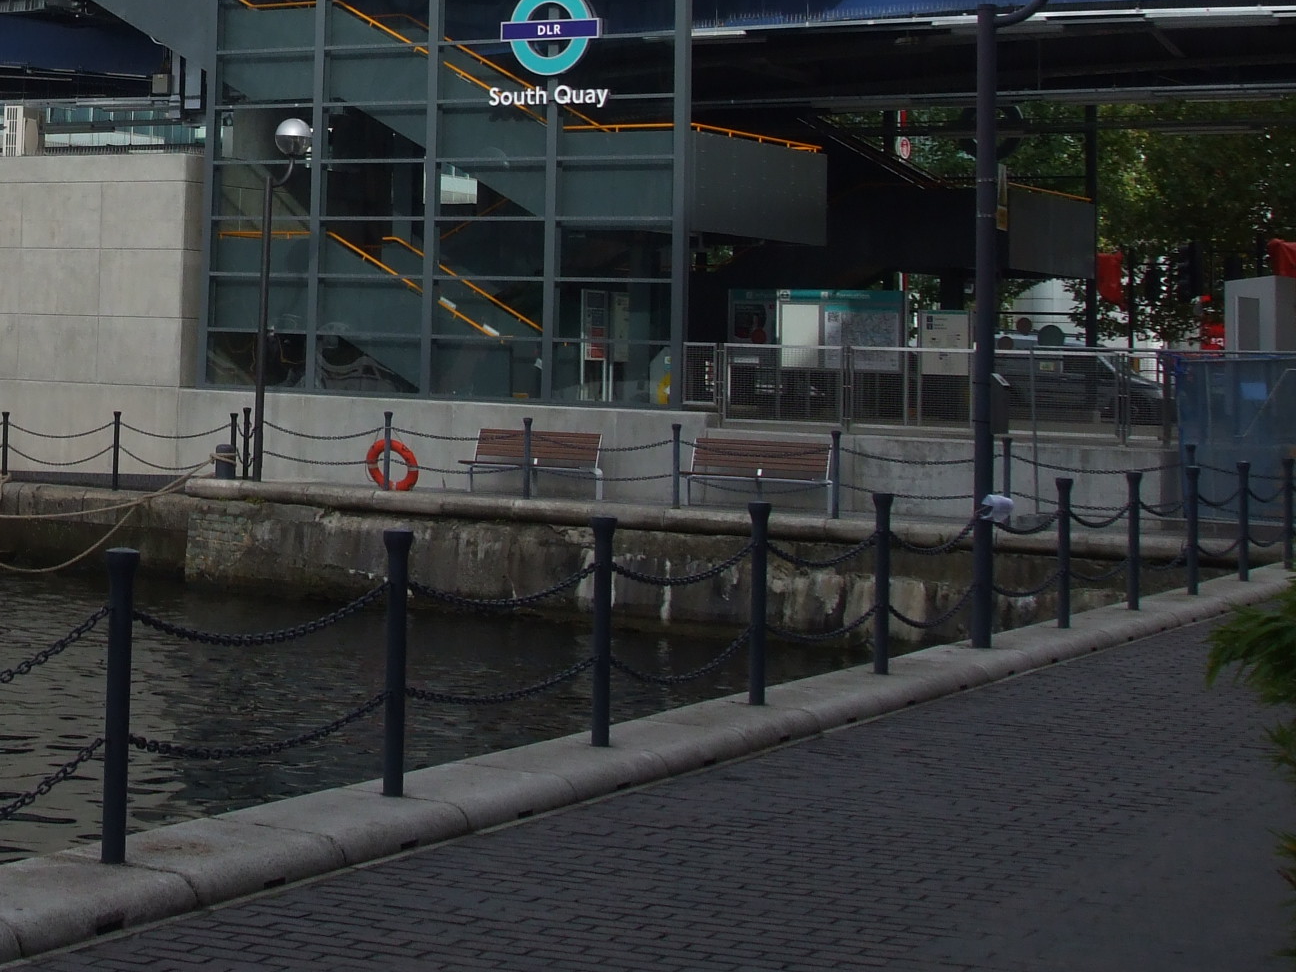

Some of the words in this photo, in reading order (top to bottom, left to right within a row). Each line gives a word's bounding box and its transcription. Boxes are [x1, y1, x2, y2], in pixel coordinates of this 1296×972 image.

[537, 24, 561, 36] DLR
[488, 86, 548, 106] South
[554, 84, 609, 108] Quay
